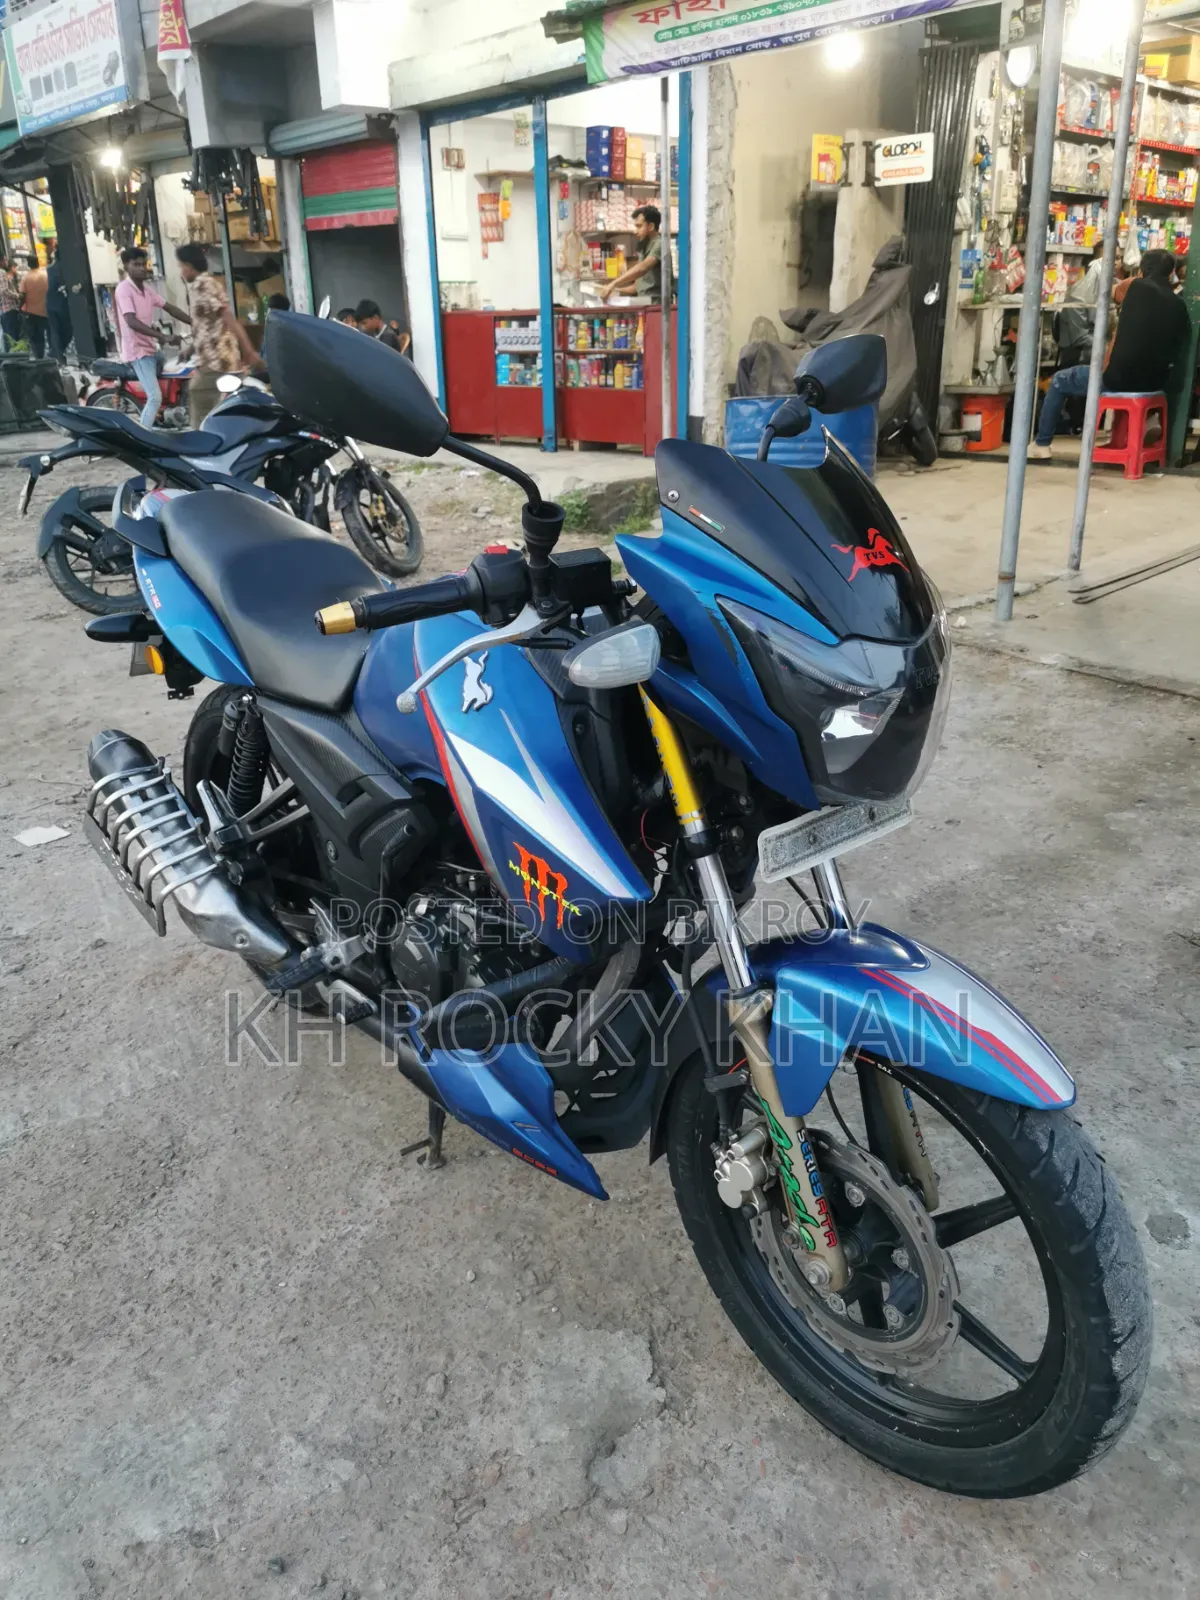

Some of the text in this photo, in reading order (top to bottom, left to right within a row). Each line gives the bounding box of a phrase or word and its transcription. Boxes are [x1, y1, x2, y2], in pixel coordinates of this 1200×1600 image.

[864, 551, 885, 561] TVS
[508, 860, 583, 917] MONSTER
[796, 1128, 825, 1198] SERIES
